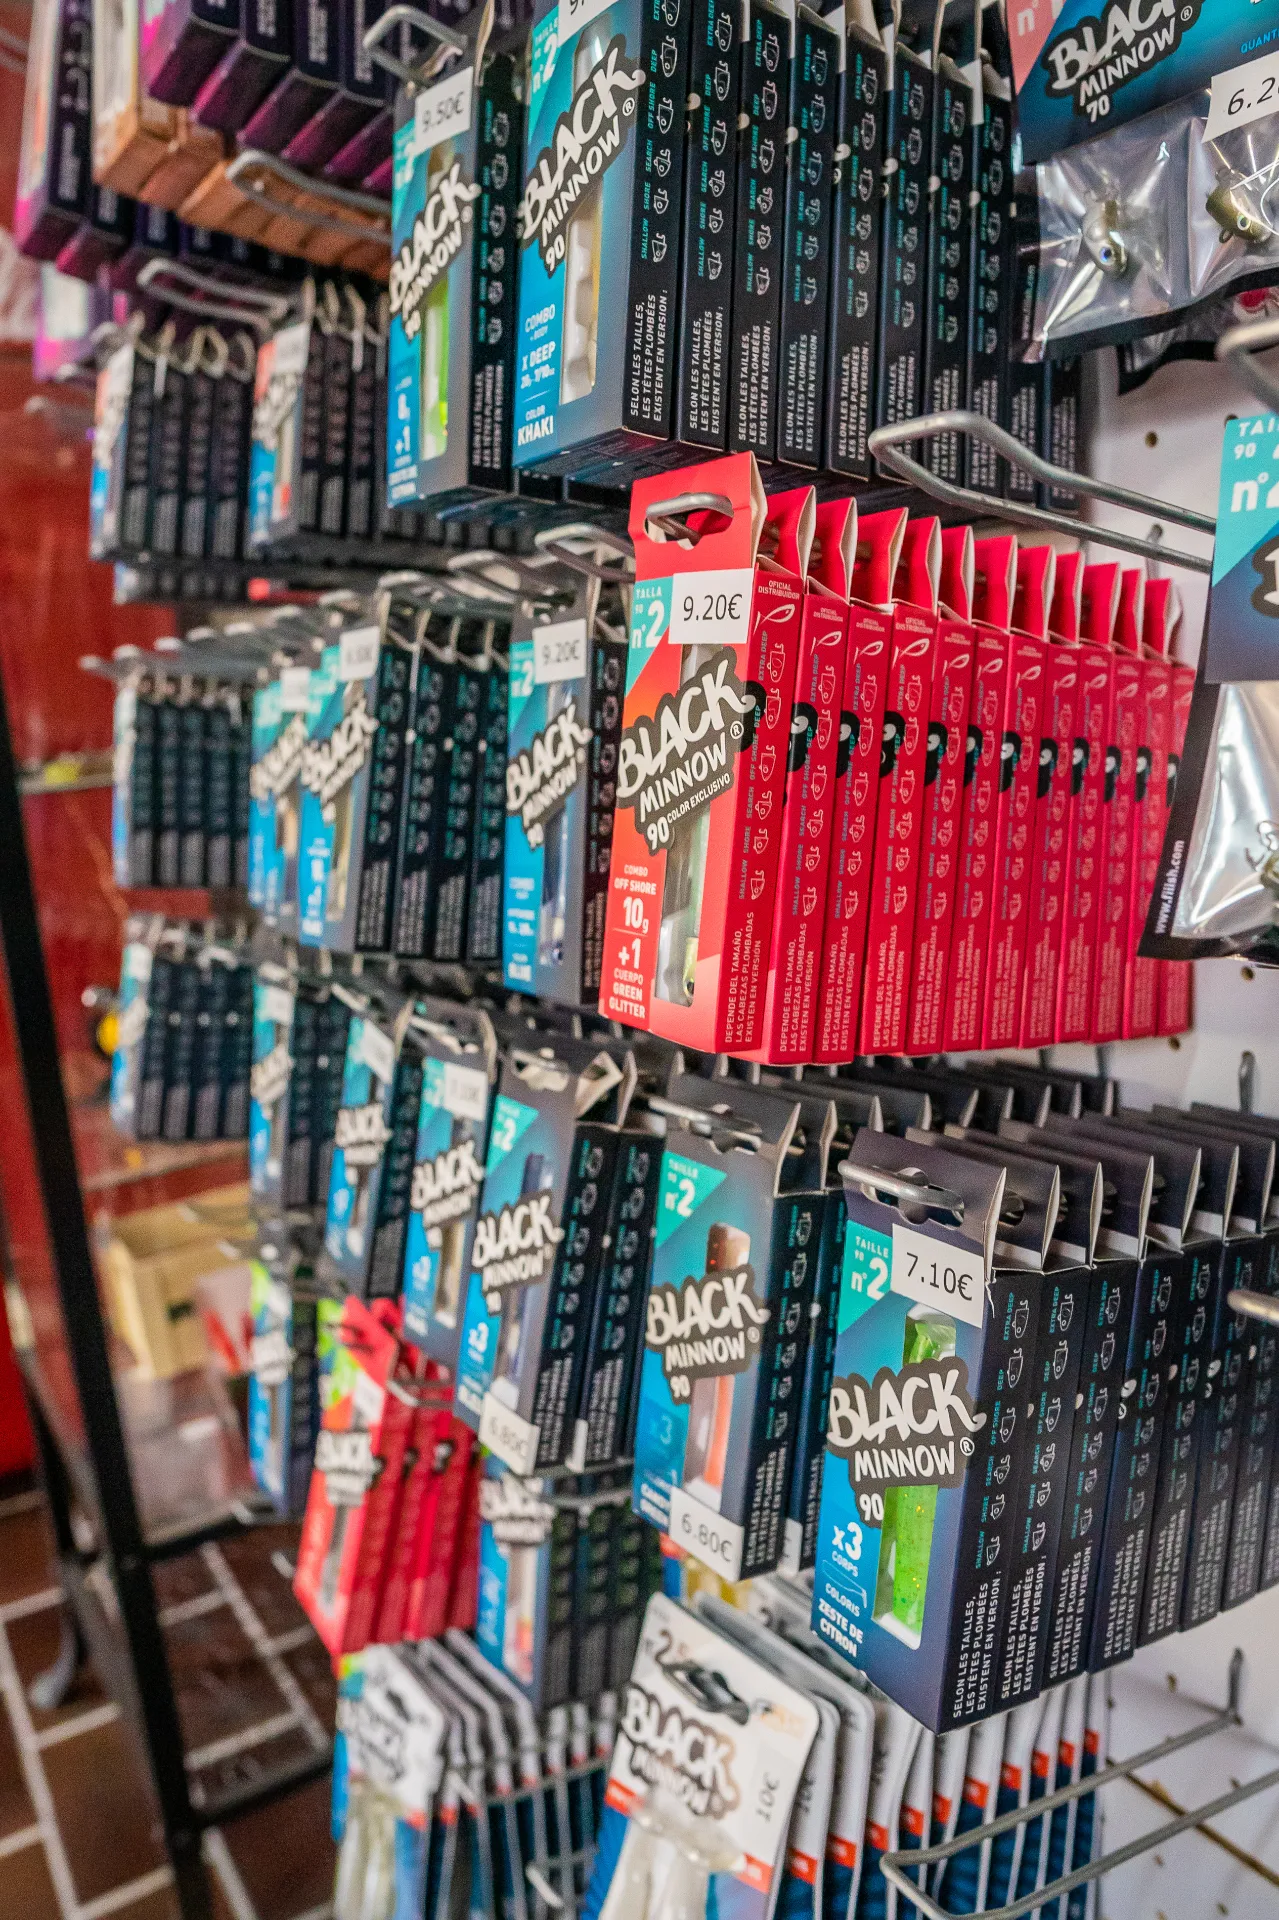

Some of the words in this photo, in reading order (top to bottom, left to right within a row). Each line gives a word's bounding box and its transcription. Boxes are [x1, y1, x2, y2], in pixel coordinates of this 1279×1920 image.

[1080, 18, 1175, 107] MINNOW
[422, 91, 464, 132] 9.50€
[1086, 95, 1110, 123] 70
[1228, 77, 1279, 115] 6.2
[522, 48, 646, 240] BLACK
[541, 116, 621, 247] MINNOW
[389, 163, 481, 312] BLACK
[546, 234, 566, 271] 90
[402, 219, 462, 320] MINNOW
[525, 304, 555, 333] COMBO
[634, 301, 644, 350] TAILLES,
[643, 293, 655, 356] PLOMBÉES
[530, 341, 556, 367] DEEP
[657, 347, 664, 363] EN
[692, 317, 701, 364] TAILLES,
[701, 310, 711, 370] PLOMBÉES
[632, 353, 641, 375] LES
[641, 358, 652, 393] TÊTES
[691, 368, 699, 389] LES
[713, 361, 721, 377] EN
[630, 378, 639, 415] SELON
[642, 397, 650, 418] LES
[653, 365, 663, 421] EXISTENT
[700, 372, 709, 406] TÊTES
[711, 379, 720, 433] EXISTENT
[689, 392, 698, 428] SELON
[1238, 418, 1279, 437] TAI
[517, 415, 554, 446] KHAKI
[1234, 443, 1256, 460] 90
[636, 586, 662, 599] TALLA
[758, 586, 800, 600] DISTRIBUIDOR
[768, 579, 791, 592] OFICIAL
[631, 600, 665, 649] n°2
[683, 594, 742, 621] 9.20€
[542, 639, 581, 665] 9.20€
[616, 659, 756, 798] BLACK
[506, 703, 593, 811] BLACK
[640, 732, 726, 823] MINNOW
[647, 817, 670, 850] 90
[666, 801, 691, 824] COLOR
[690, 772, 730, 804] EXCLUSIVO
[614, 878, 629, 890] OFF
[630, 880, 657, 895] SHORE
[624, 864, 648, 877] COMBO
[739, 859, 747, 899] SHALLOW
[623, 896, 649, 934] 10g
[729, 927, 742, 972] TAMAÑO,
[742, 911, 754, 973] PLOMBADAS
[749, 939, 761, 983] VERSIÓN
[613, 982, 643, 1001] GREEN
[614, 968, 643, 985] CUERPO
[729, 974, 738, 993] DEL
[749, 984, 757, 997] EN
[609, 997, 645, 1019] GLITTER
[737, 974, 748, 1020] CABEZAS
[725, 996, 736, 1042] DEPENDE
[735, 1022, 743, 1042] LAS
[745, 1000, 755, 1042] EXISTEN
[472, 1195, 565, 1268] BLACK
[855, 1236, 889, 1258] TAILLE
[851, 1257, 888, 1300] n°2
[906, 1252, 973, 1301] 7.10€
[646, 1272, 771, 1345] BLACK
[1006, 1292, 1014, 1312] DEEP
[1003, 1312, 1011, 1340] EXTRA
[665, 1331, 745, 1372] MINNOW
[670, 1374, 691, 1398] 90
[996, 1368, 1004, 1390] DEEP
[826, 1369, 987, 1447] BLACK
[855, 1441, 955, 1482] MINNOW
[985, 1455, 993, 1486] SEARCH
[859, 1493, 884, 1521] 90
[981, 1495, 989, 1522] SHORE
[681, 1513, 733, 1562] 6.80€
[832, 1521, 863, 1560] x3
[975, 1530, 984, 1569] SHALLOW
[832, 1550, 858, 1577] CORPS
[825, 1583, 860, 1617] COLORIS
[971, 1581, 988, 1648] PLOMBÉES
[819, 1598, 848, 1632] ZESTE
[849, 1623, 863, 1644] DE
[820, 1617, 857, 1658] CITRON
[960, 1594, 976, 1650] TAILLES,
[957, 1651, 968, 1675] LES
[967, 1650, 980, 1688] TÊTES
[977, 1652, 991, 1710] EXISTENT
[984, 1632, 993, 1649] EN
[952, 1677, 965, 1717] SELON
[965, 1691, 975, 1714] LES
[622, 1687, 739, 1809] BLACK
[756, 1771, 780, 1822] 10€
